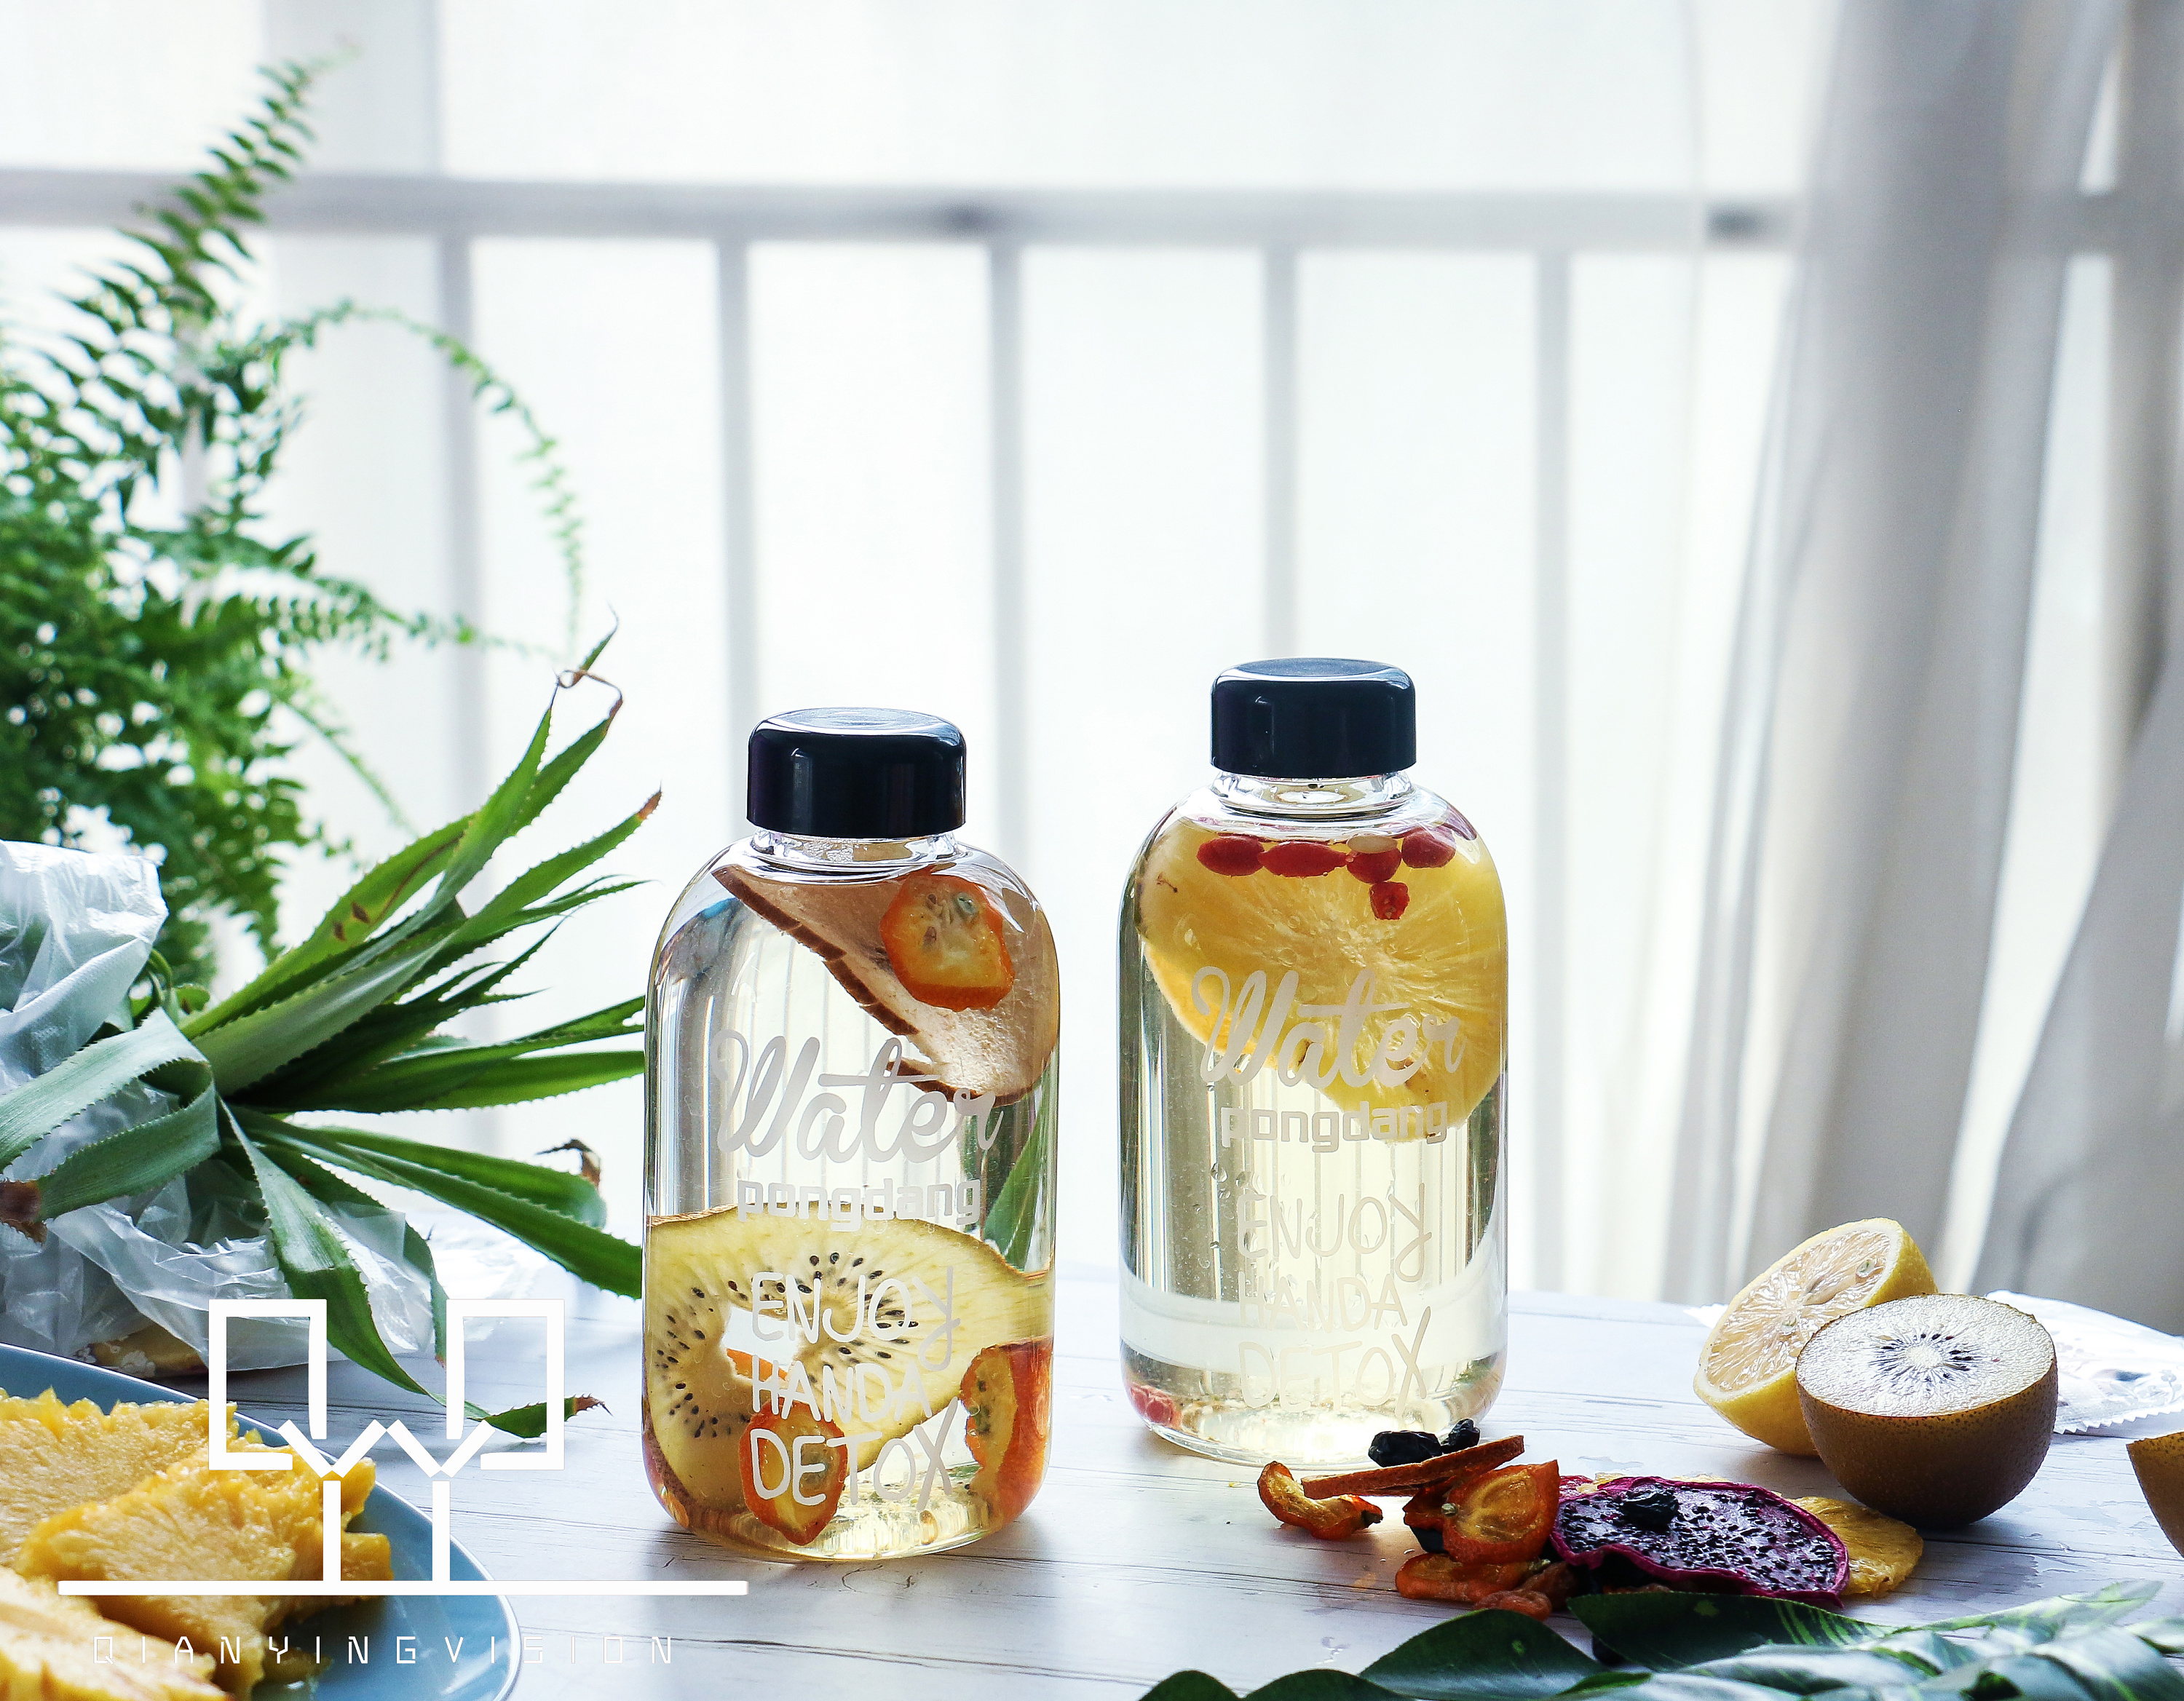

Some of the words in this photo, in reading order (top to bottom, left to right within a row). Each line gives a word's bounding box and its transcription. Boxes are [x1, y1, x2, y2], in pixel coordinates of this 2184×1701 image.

[1190, 965, 1468, 1087] Water
[710, 1028, 1004, 1163] Water
[1220, 1101, 1447, 1153] pongdang
[737, 1178, 981, 1232] pongdang
[1238, 1183, 1432, 1282] ENJOY
[751, 1265, 961, 1371] ENJOY
[1238, 1272, 1407, 1333] HANDA
[752, 1354, 938, 1424] HANDA
[1238, 1306, 1431, 1416] DETOX
[749, 1395, 959, 1511] DETOX
